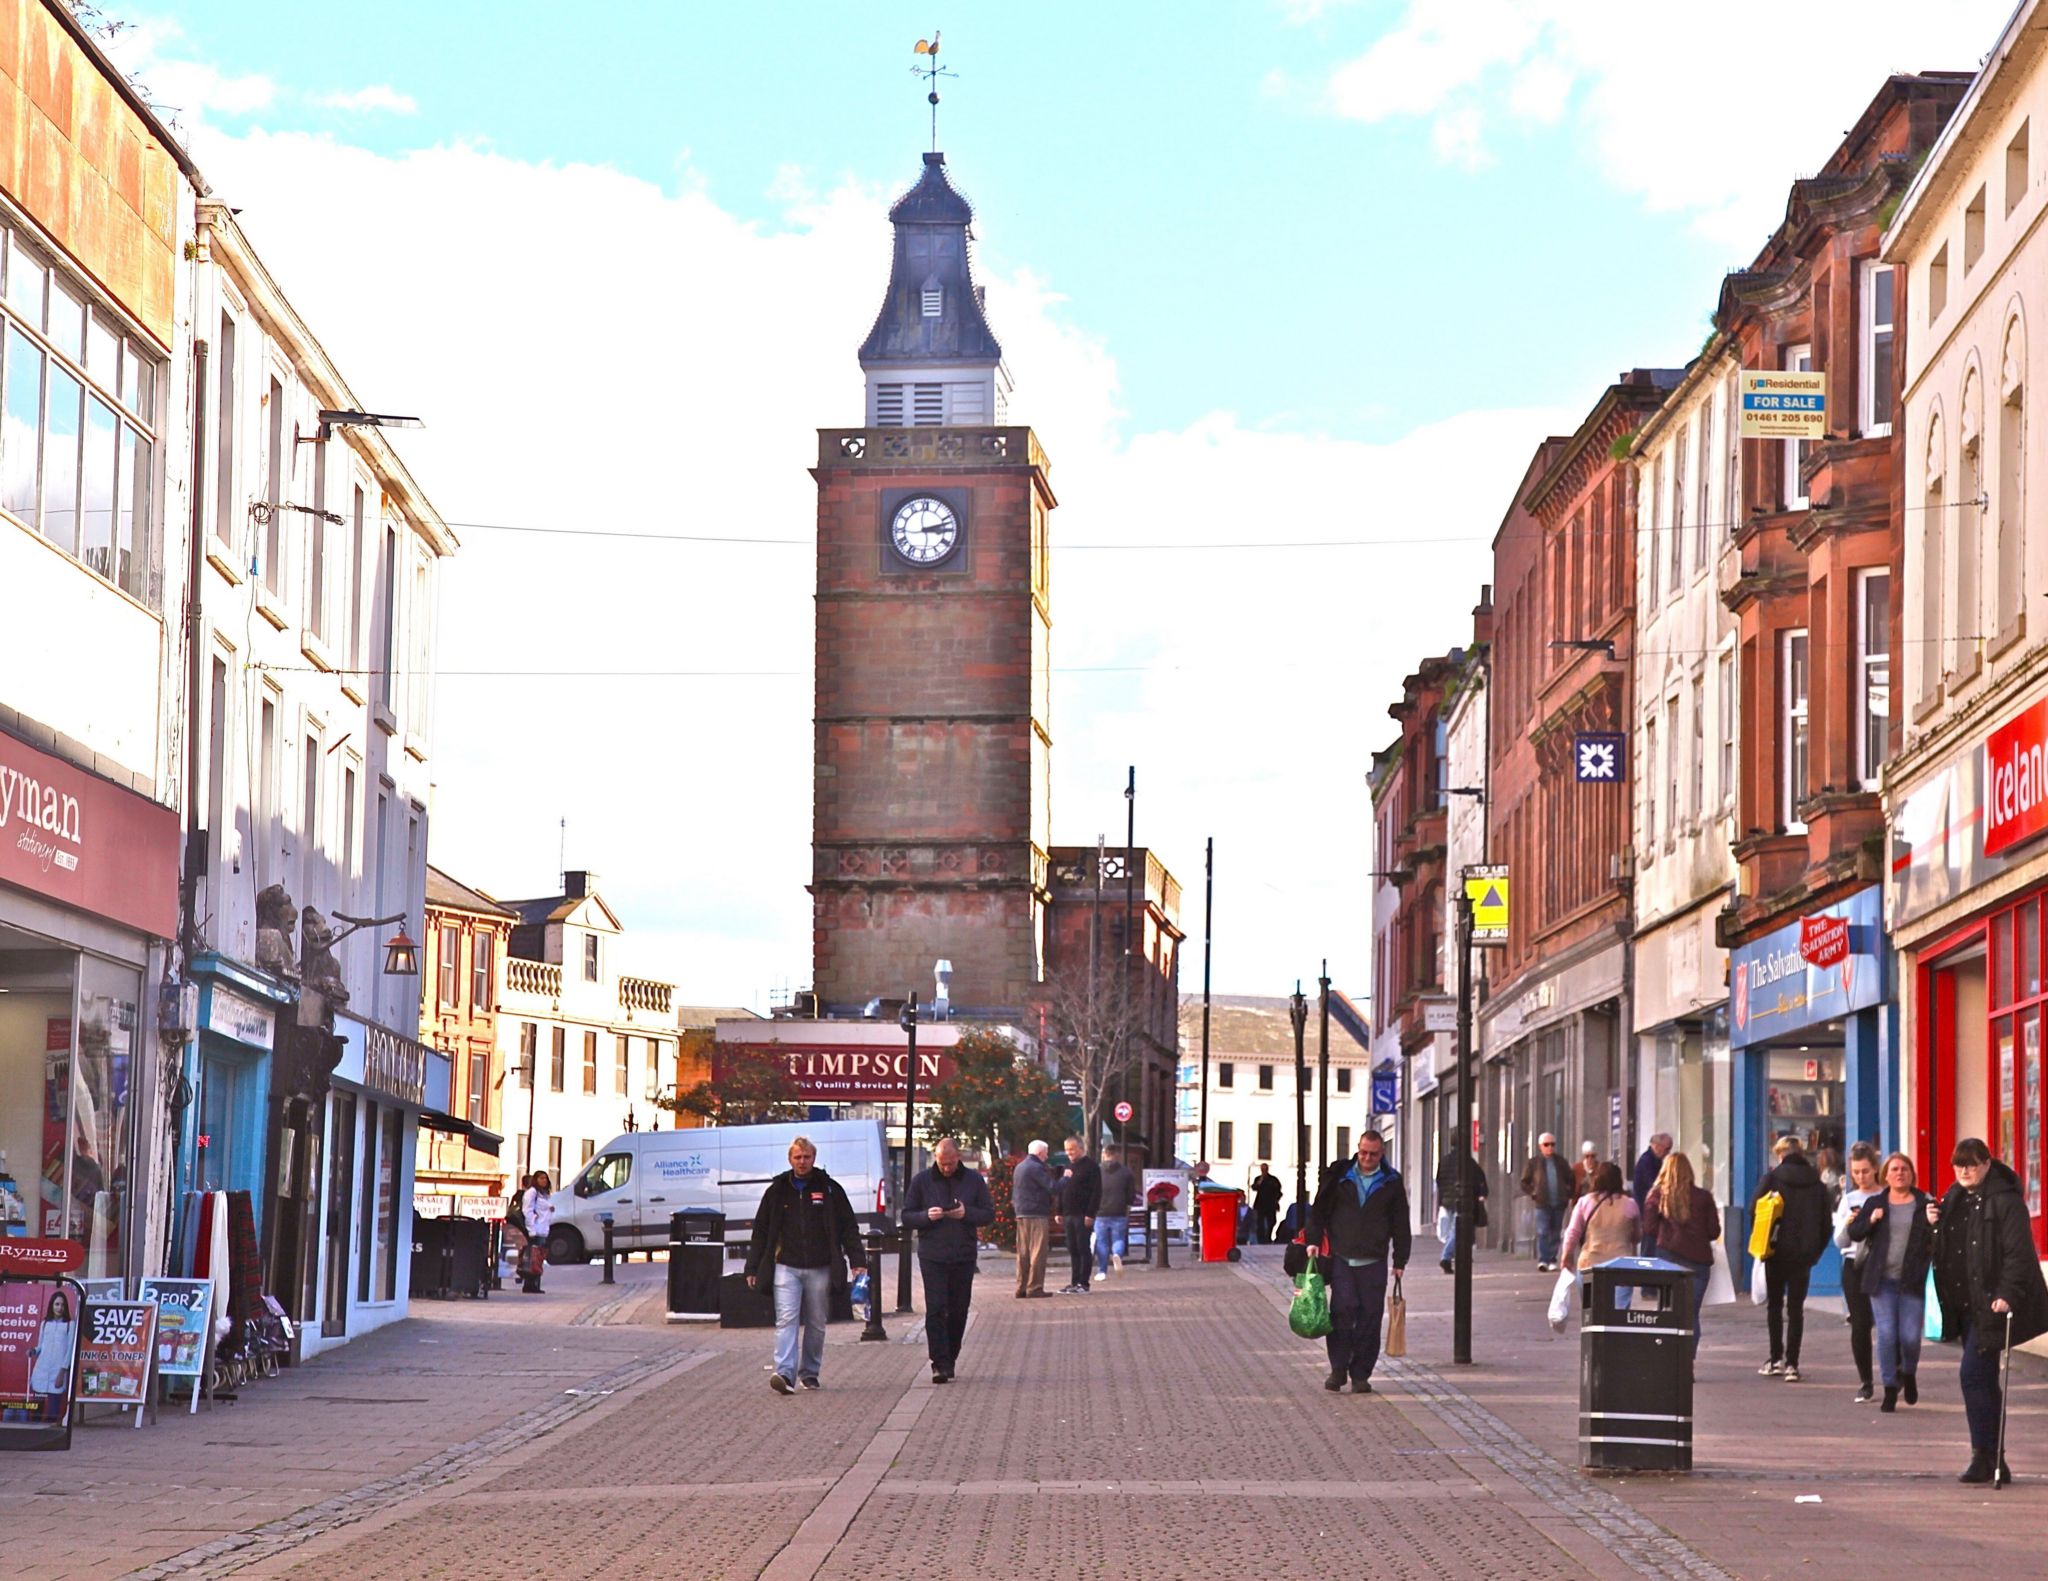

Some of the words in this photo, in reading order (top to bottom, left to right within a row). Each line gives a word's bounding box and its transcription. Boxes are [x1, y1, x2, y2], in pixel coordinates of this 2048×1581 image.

[1754, 396, 1780, 408] FOR
[1783, 397, 1816, 409] SALE
[1746, 413, 1778, 422] 01461
[1781, 414, 1801, 422] 205
[1804, 415, 1823, 423] 690
[1808, 919, 1828, 937] THE
[1802, 924, 1845, 957] SALVATION
[1817, 938, 1844, 962] ARMY
[1752, 958, 1767, 989] The
[784, 1052, 942, 1077] TIMPSON
[815, 1081, 851, 1089] Quality
[654, 1159, 689, 1169] Alliance
[662, 1167, 711, 1177] Healthcare
[463, 1198, 479, 1206] FOR
[481, 1198, 499, 1206] SALE
[484, 1208, 497, 1216] LET
[0, 1245, 69, 1258] Ryman
[160, 1293, 189, 1307] FOR
[189, 1289, 204, 1312] 2
[28, 1304, 39, 1316] &
[93, 1308, 145, 1327] SAVE
[1626, 1312, 1659, 1324] Litter
[92, 1326, 138, 1345] 25%
[80, 1351, 98, 1360] INK
[100, 1351, 109, 1360] &
[111, 1351, 146, 1361] TONER
